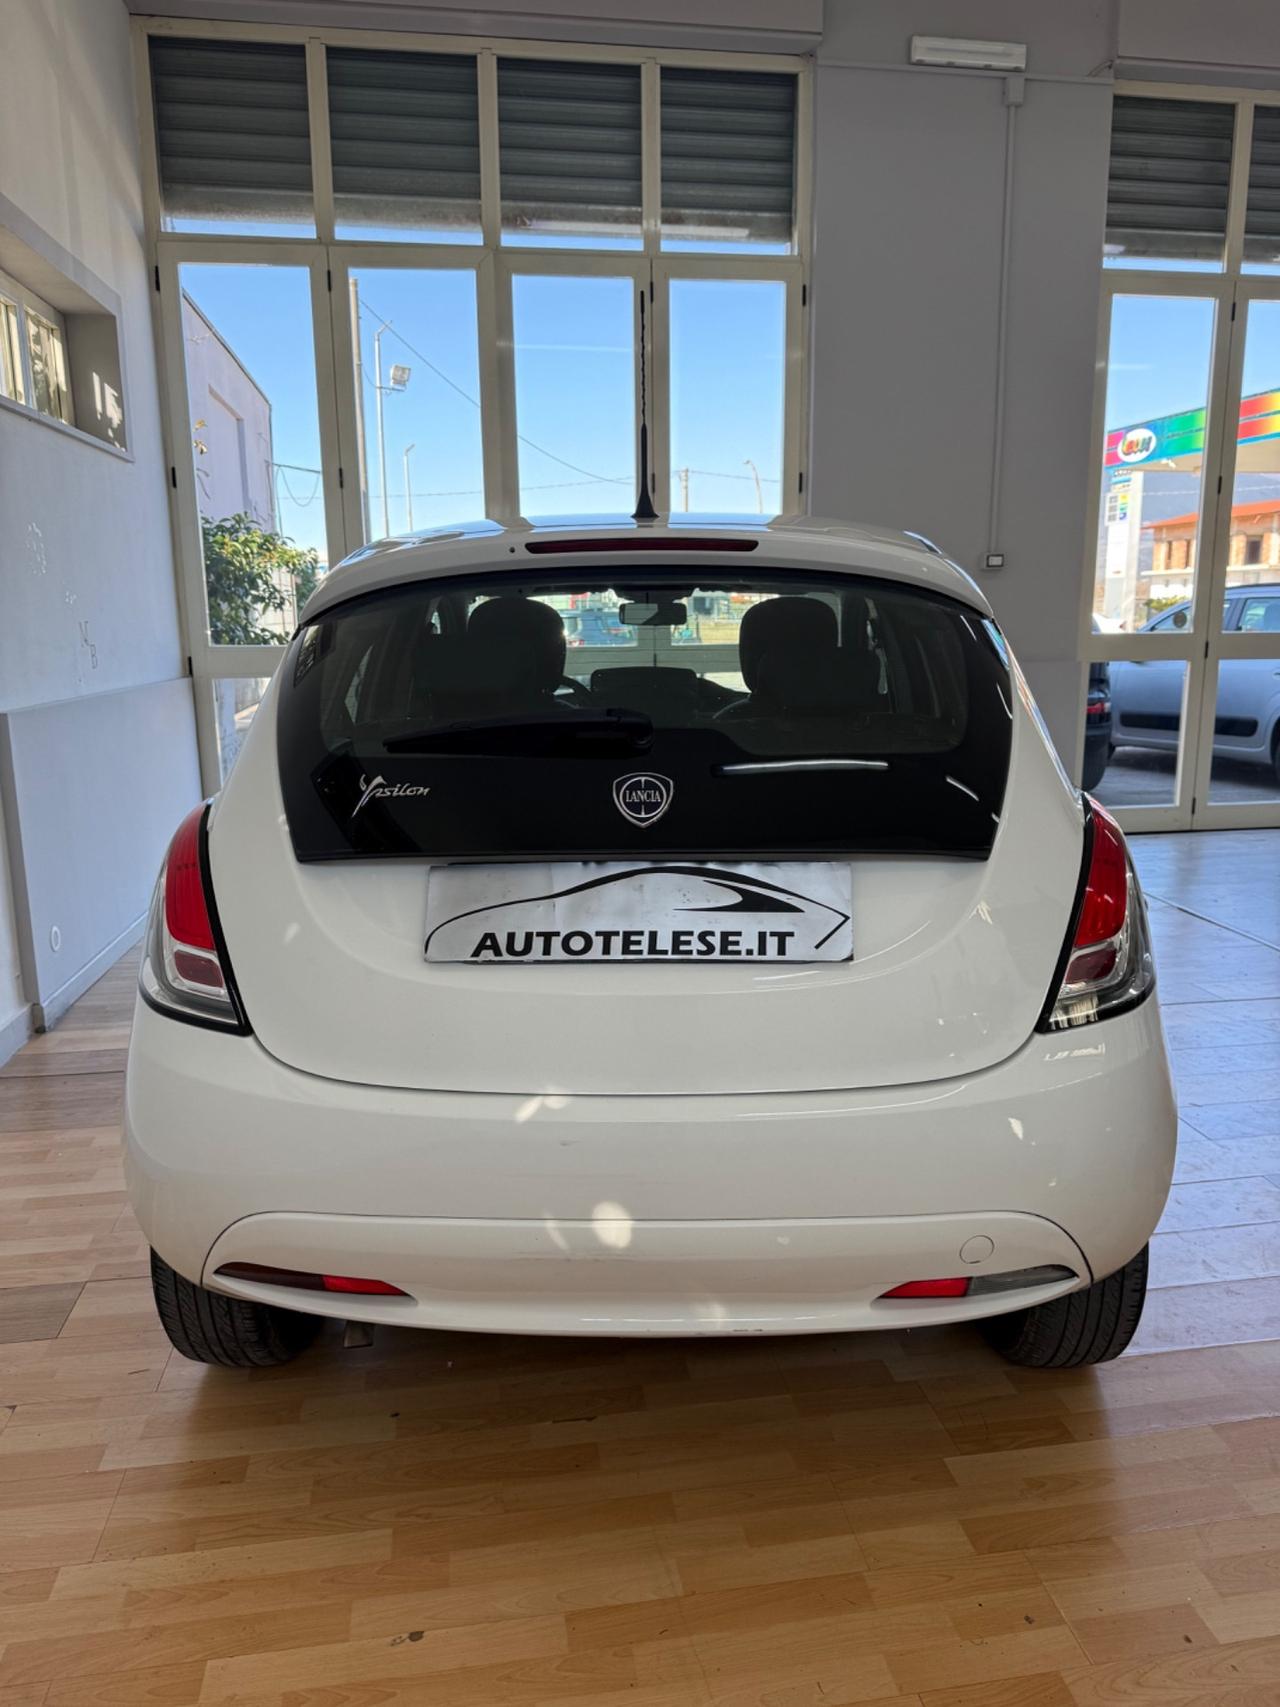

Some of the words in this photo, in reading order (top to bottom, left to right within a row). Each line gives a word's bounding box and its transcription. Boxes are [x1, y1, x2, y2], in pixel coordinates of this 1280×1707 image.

[352, 773, 431, 818] Ypsilon
[625, 789, 661, 803] LANCIA
[469, 929, 796, 960] AUTOTELESE.IT
